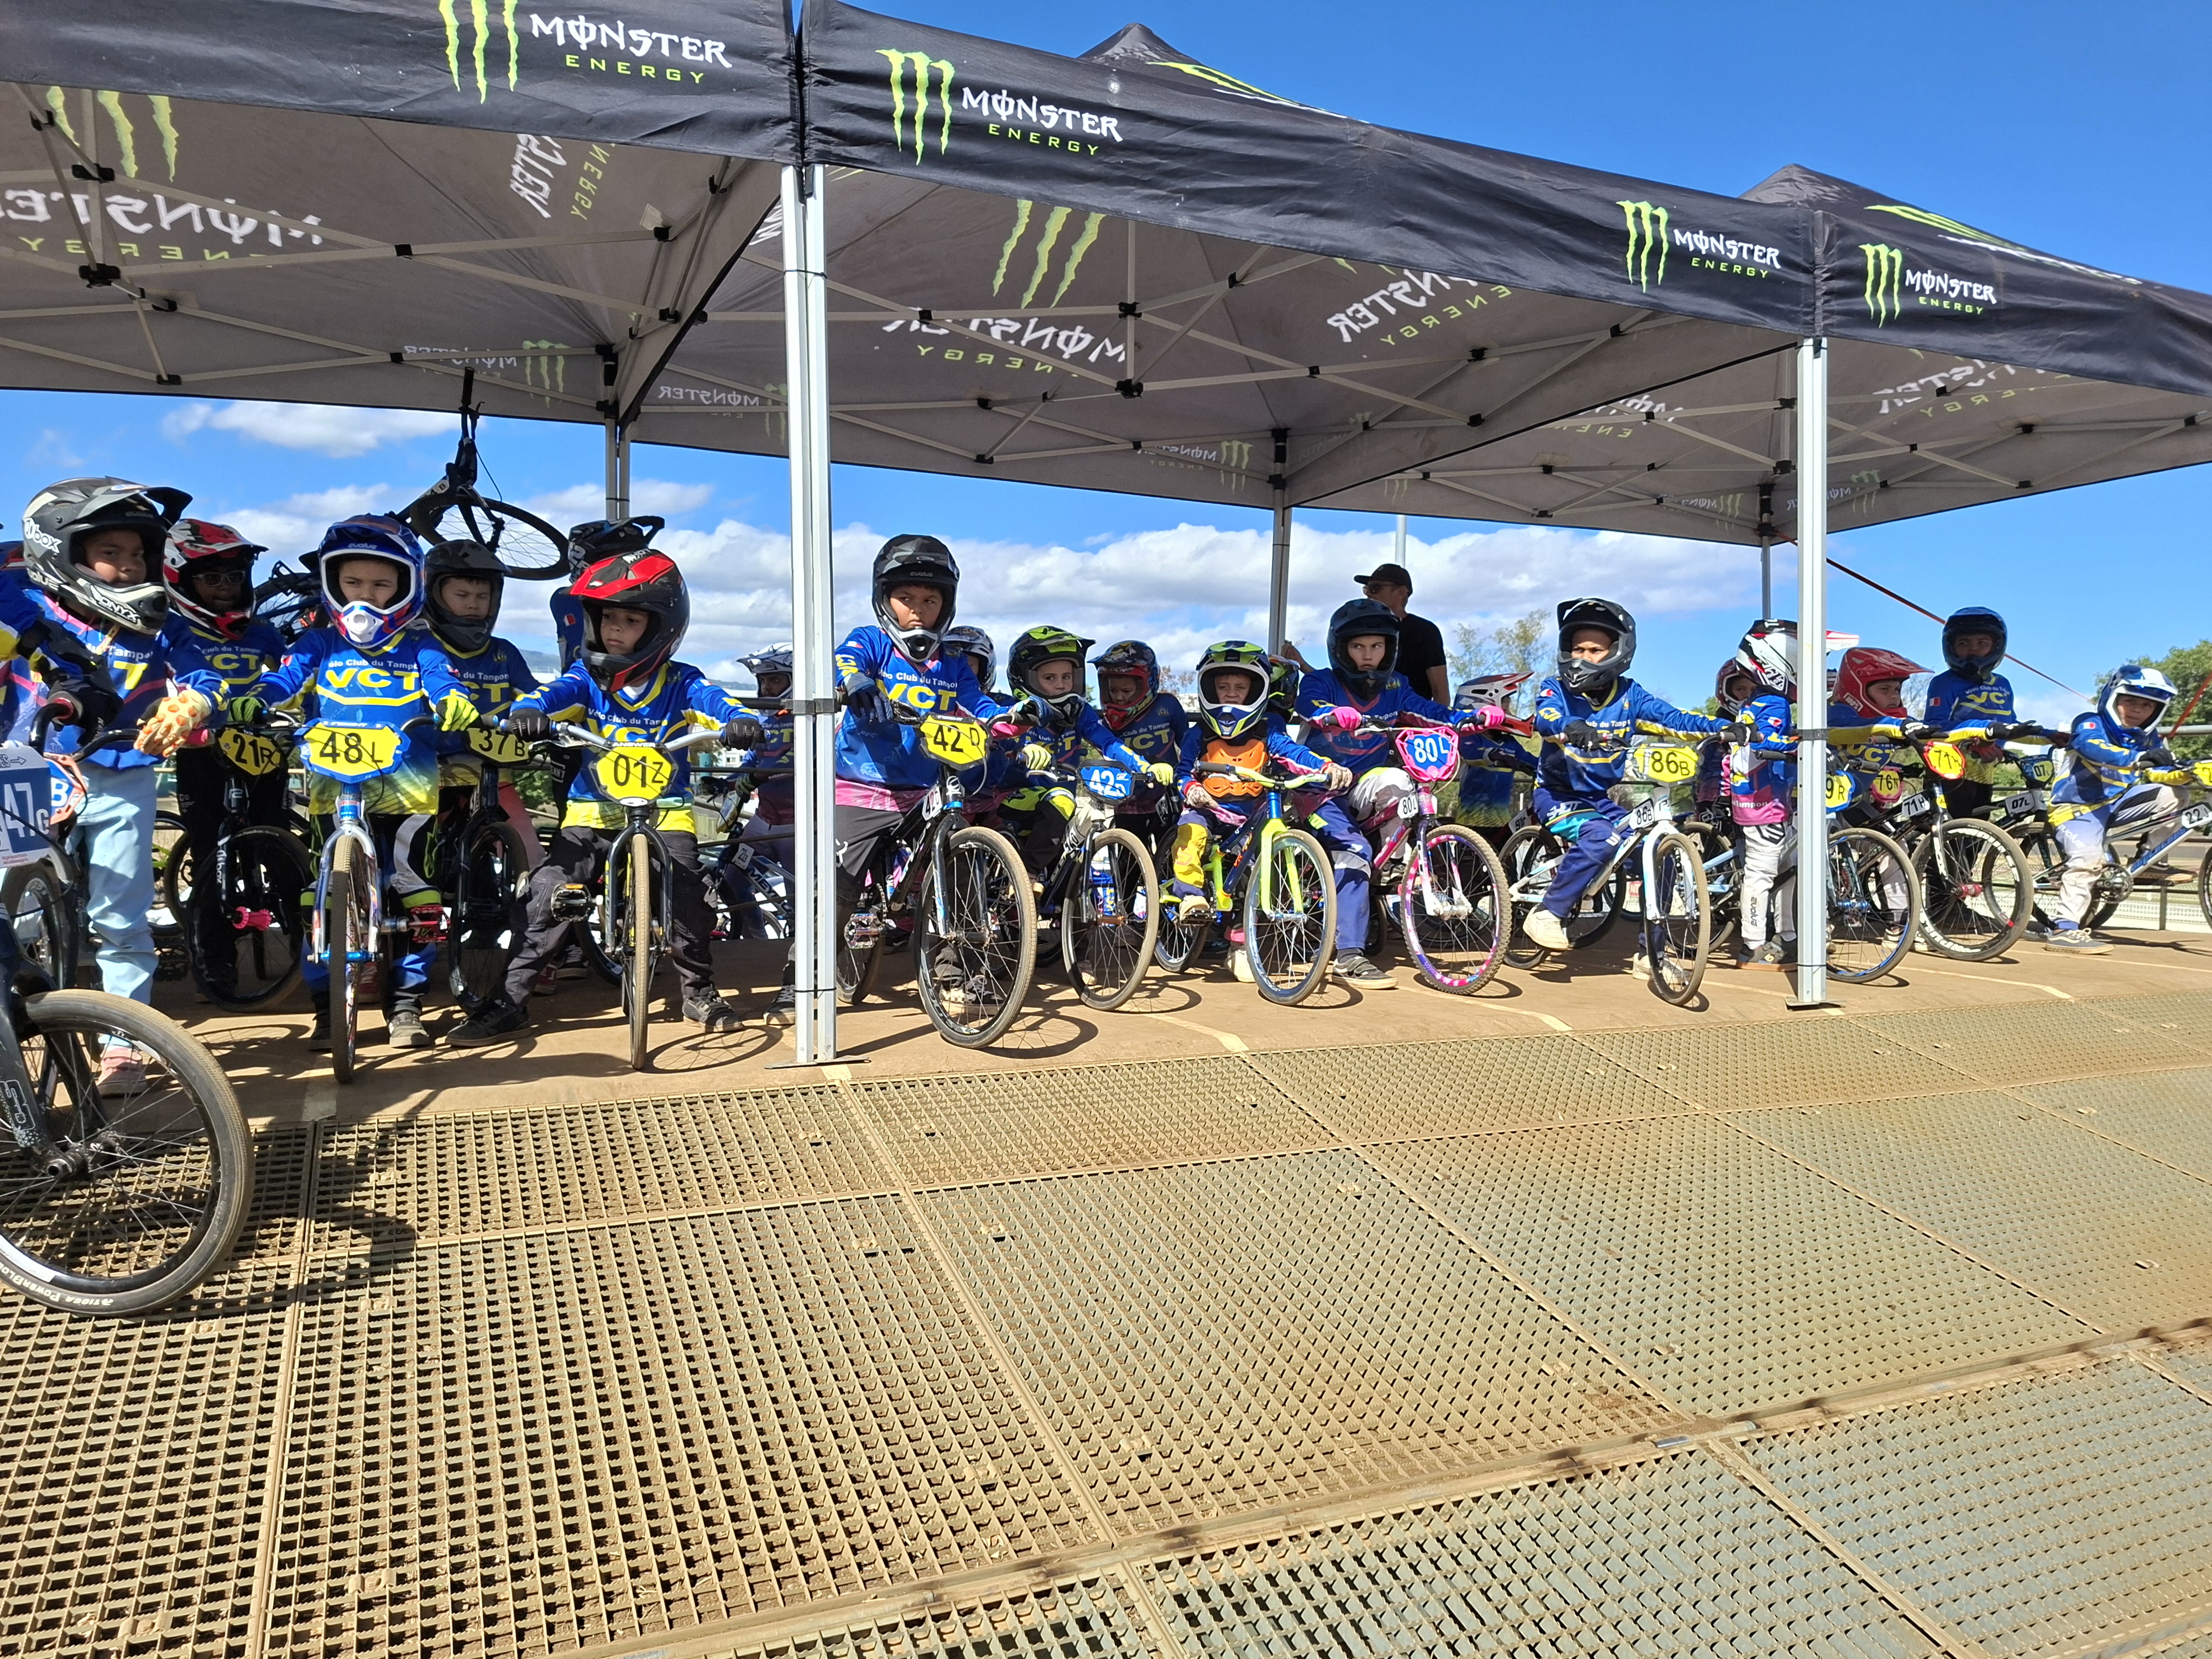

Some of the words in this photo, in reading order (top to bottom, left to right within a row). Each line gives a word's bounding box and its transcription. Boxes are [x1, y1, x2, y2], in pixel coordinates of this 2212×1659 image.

[530, 13, 732, 67] MONSTER
[566, 54, 704, 84] ENERGY
[962, 86, 1123, 142] MONSTER
[989, 123, 1099, 155] ENERGY
[1673, 228, 1781, 269] MONSTER
[1691, 257, 1770, 278] ENERGY
[1904, 268, 1997, 305] MONSTER
[1918, 296, 1984, 315] ENERGY
[101, 597, 141, 623] ONYX
[205, 654, 259, 670] CT
[325, 667, 420, 690] VCT
[896, 672, 918, 682] Club
[459, 681, 510, 703] CT
[875, 678, 957, 711] VCT
[608, 714, 627, 723] Club
[232, 733, 276, 768] 21R
[320, 731, 384, 764] 48L
[478, 728, 526, 758] 37B
[933, 724, 980, 753] 42D
[1413, 737, 1449, 763] 80L
[613, 753, 664, 788] 01Z
[1651, 750, 1691, 776] 86B
[1089, 769, 1126, 797] 42D
[1825, 776, 1845, 801] 9R
[1636, 805, 1653, 825] 86B
[2011, 796, 2031, 810] 07L
